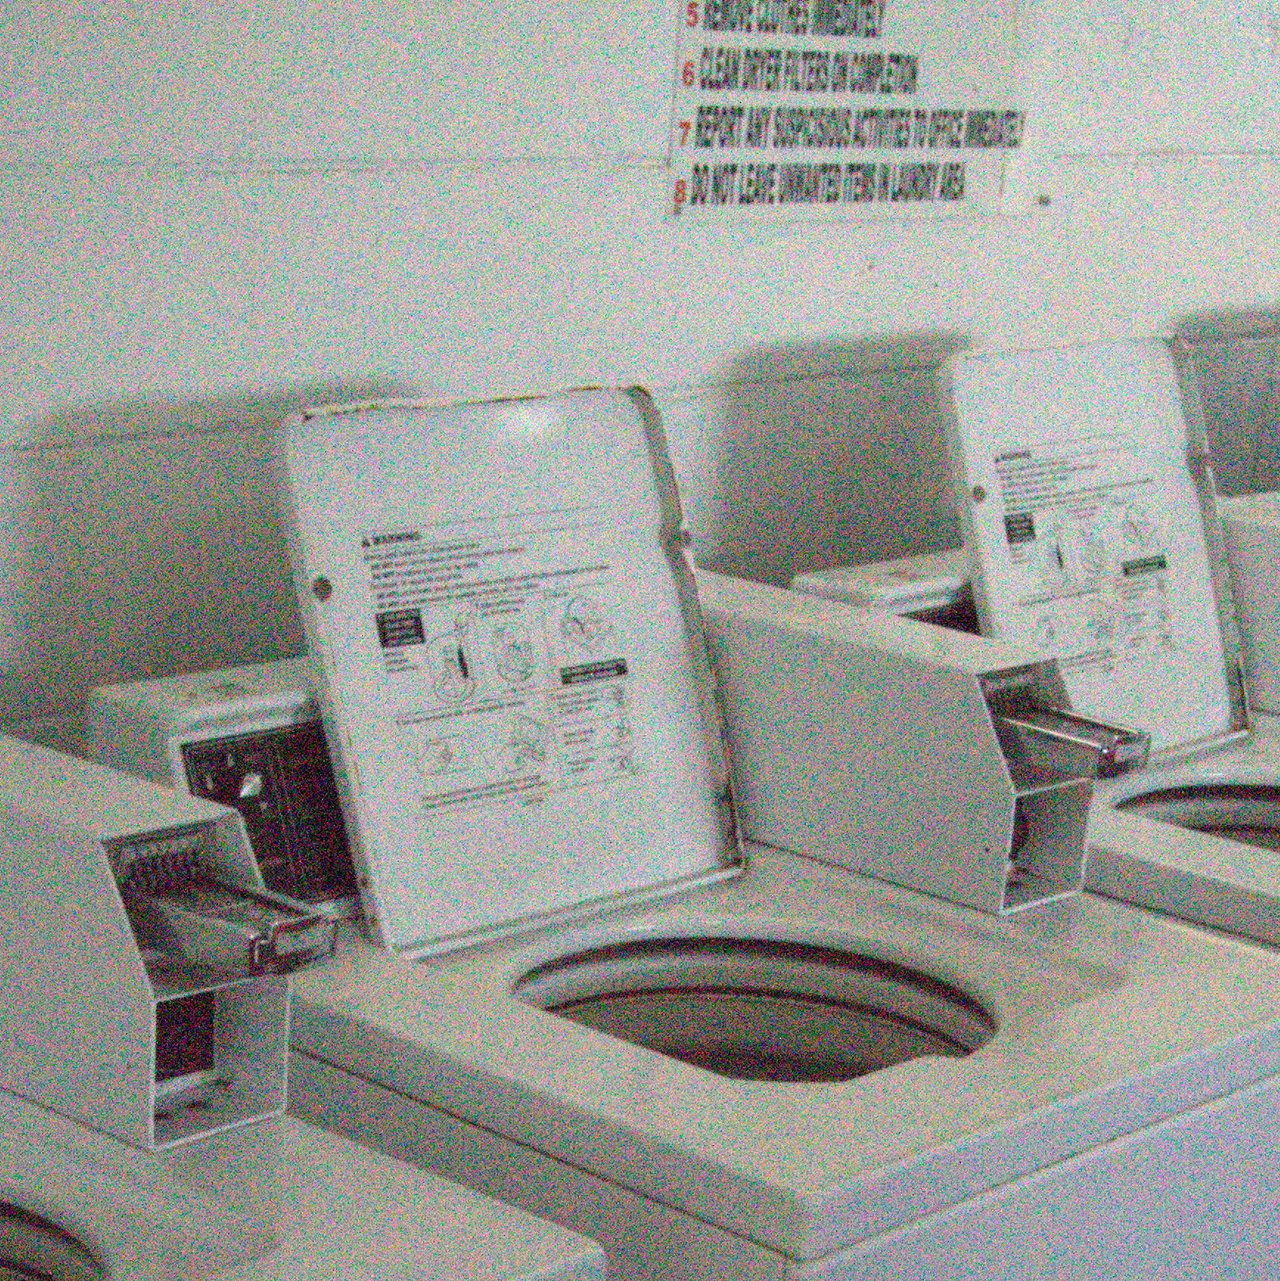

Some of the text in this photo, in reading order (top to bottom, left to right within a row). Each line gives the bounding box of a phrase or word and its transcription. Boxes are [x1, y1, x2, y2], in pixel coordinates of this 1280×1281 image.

[686, 0, 886, 37] 5 REMOVE CLOTHES IMMEDIATELY
[681, 47, 918, 94] 6 CLEAN DRYER FILTERS ON COMPLETION
[678, 121, 691, 147] 7
[694, 106, 746, 148] REPORT
[746, 107, 774, 147] ANY
[912, 109, 929, 148] TO
[928, 110, 965, 148] OFFICE
[674, 180, 686, 204] 8
[690, 164, 711, 205] DO
[711, 164, 739, 204] NOT
[739, 164, 778, 203] LEAVE
[778, 164, 843, 203] UNWANTED
[843, 163, 877, 202] ITEMS
[877, 164, 890, 201] IN
[939, 163, 968, 199] AREA
